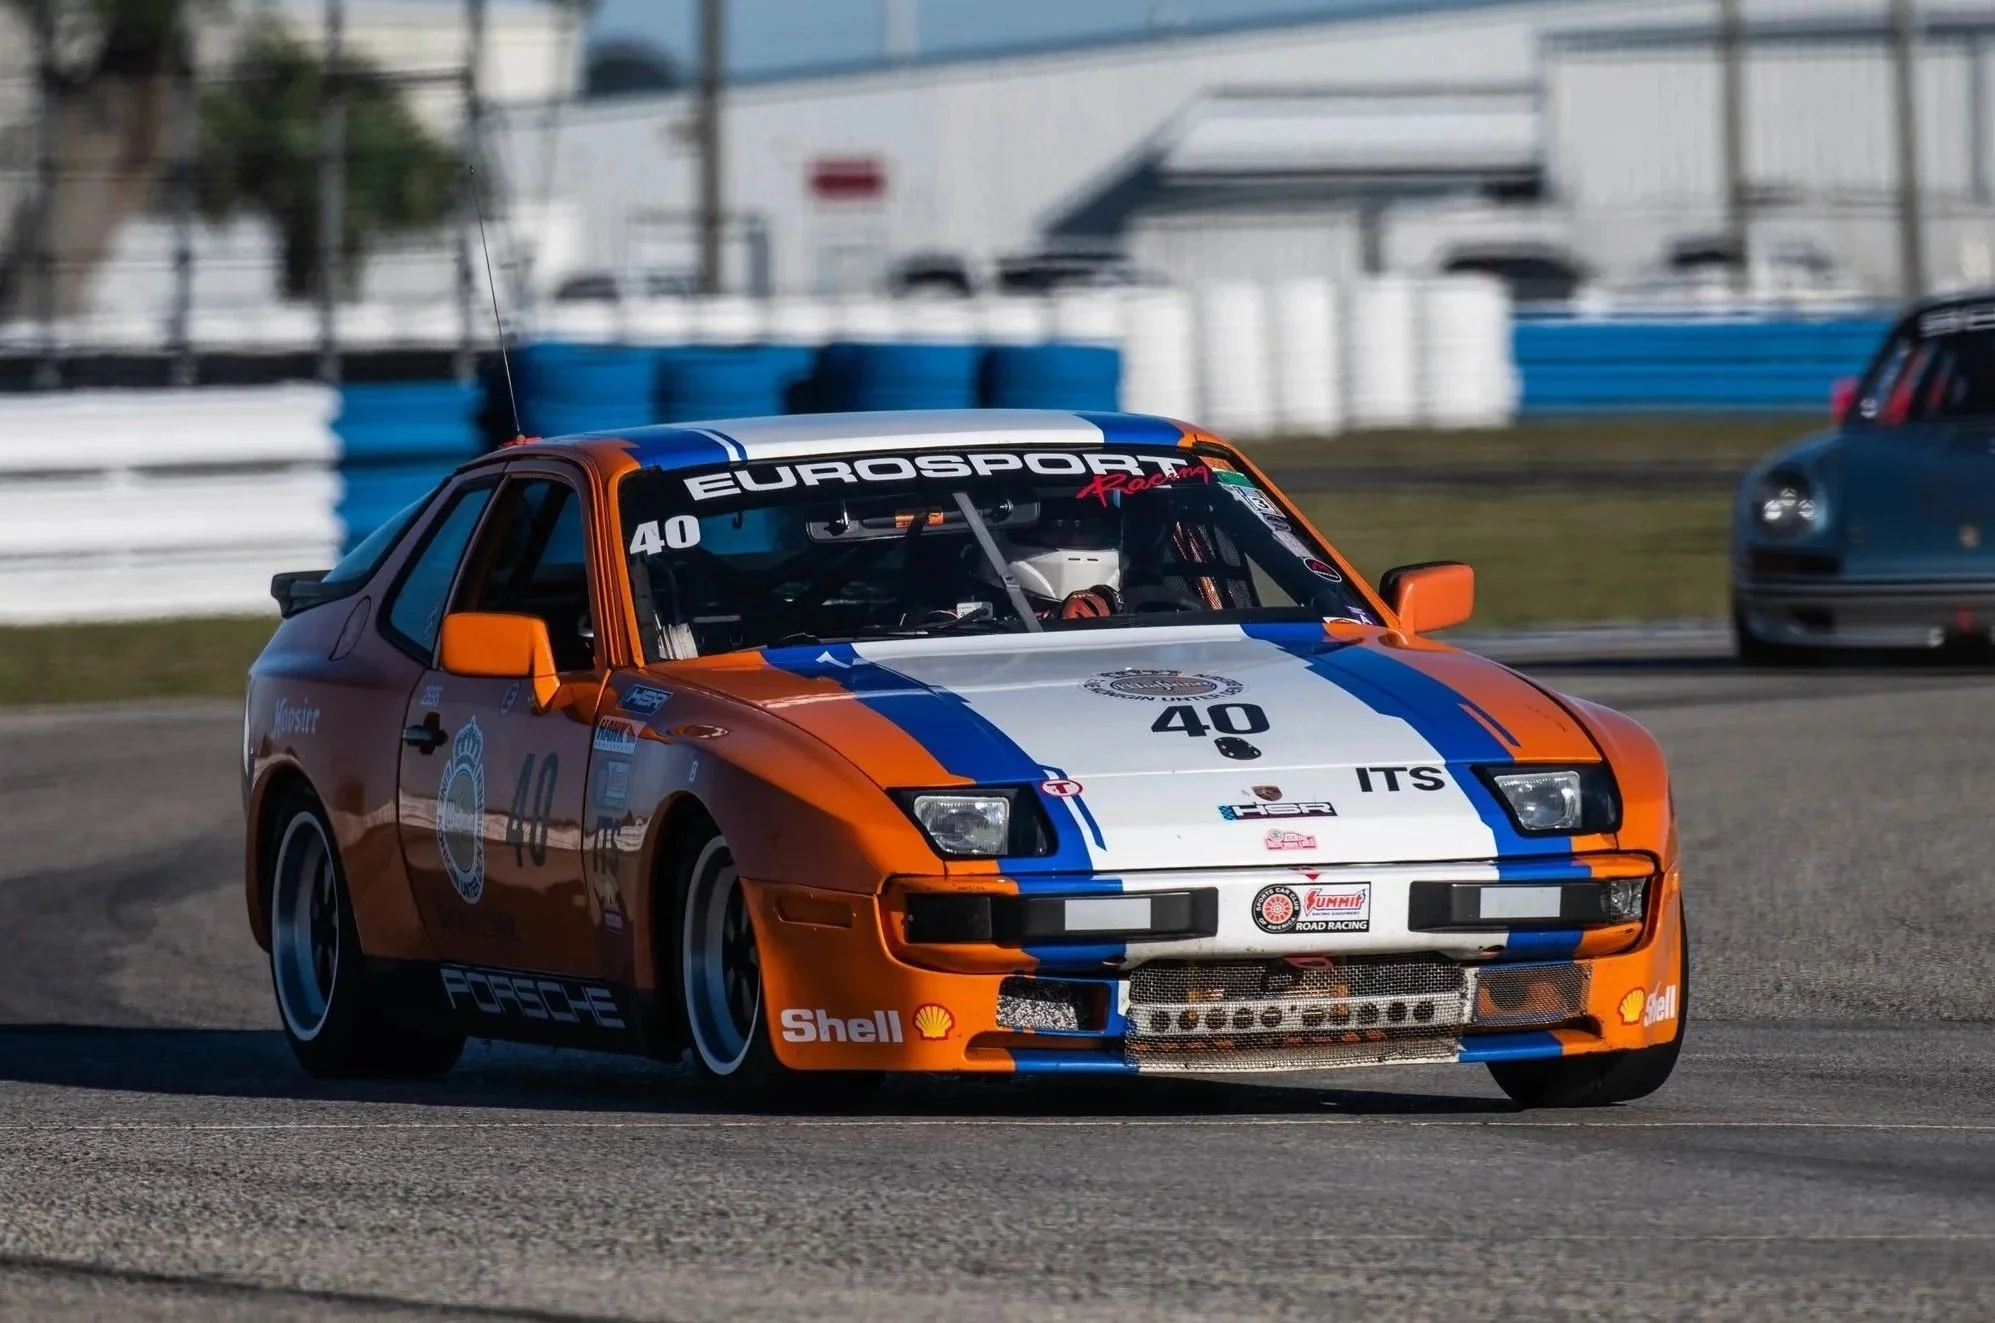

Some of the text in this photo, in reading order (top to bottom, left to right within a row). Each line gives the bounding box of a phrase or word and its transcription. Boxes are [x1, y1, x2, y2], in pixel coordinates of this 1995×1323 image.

[684, 453, 1187, 501] EUROSPORT
[1075, 465, 1209, 508] Racing
[629, 515, 701, 555] 40
[625, 687, 670, 708] HSR
[1151, 702, 1270, 737] 40
[1355, 766, 1445, 792] ITS
[505, 752, 559, 869] 40
[1232, 802, 1334, 817] HSR
[1256, 887, 1300, 911] SPORTS CAR CLUB
[1259, 917, 1297, 930] OF AMERICA
[1295, 921, 1367, 931] ROAD RACING
[440, 967, 626, 1029] PORSCHE
[780, 1008, 904, 1043] Shell
